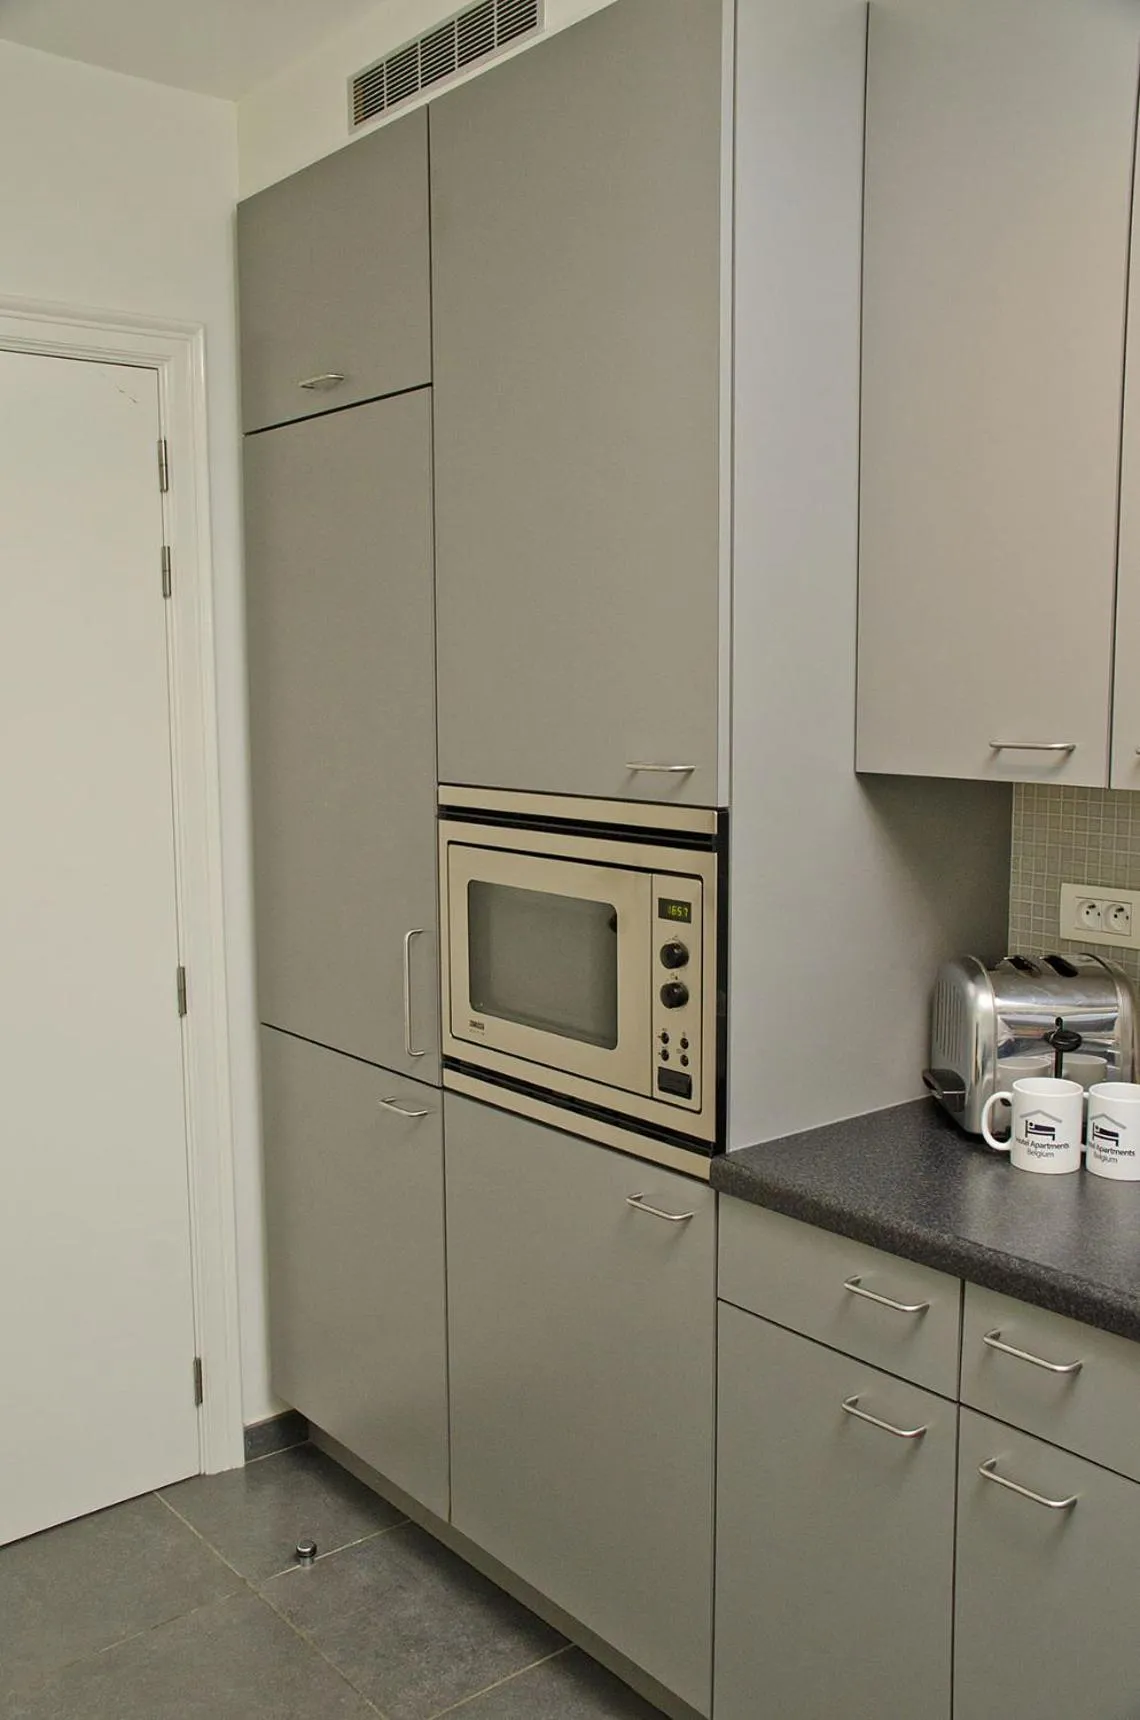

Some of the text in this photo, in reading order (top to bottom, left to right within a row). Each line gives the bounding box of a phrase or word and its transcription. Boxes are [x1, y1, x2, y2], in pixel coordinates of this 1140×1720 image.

[1030, 1141, 1070, 1150] Apartments
[1096, 1144, 1135, 1156] Apartments
[1027, 1148, 1055, 1158] Belgium
